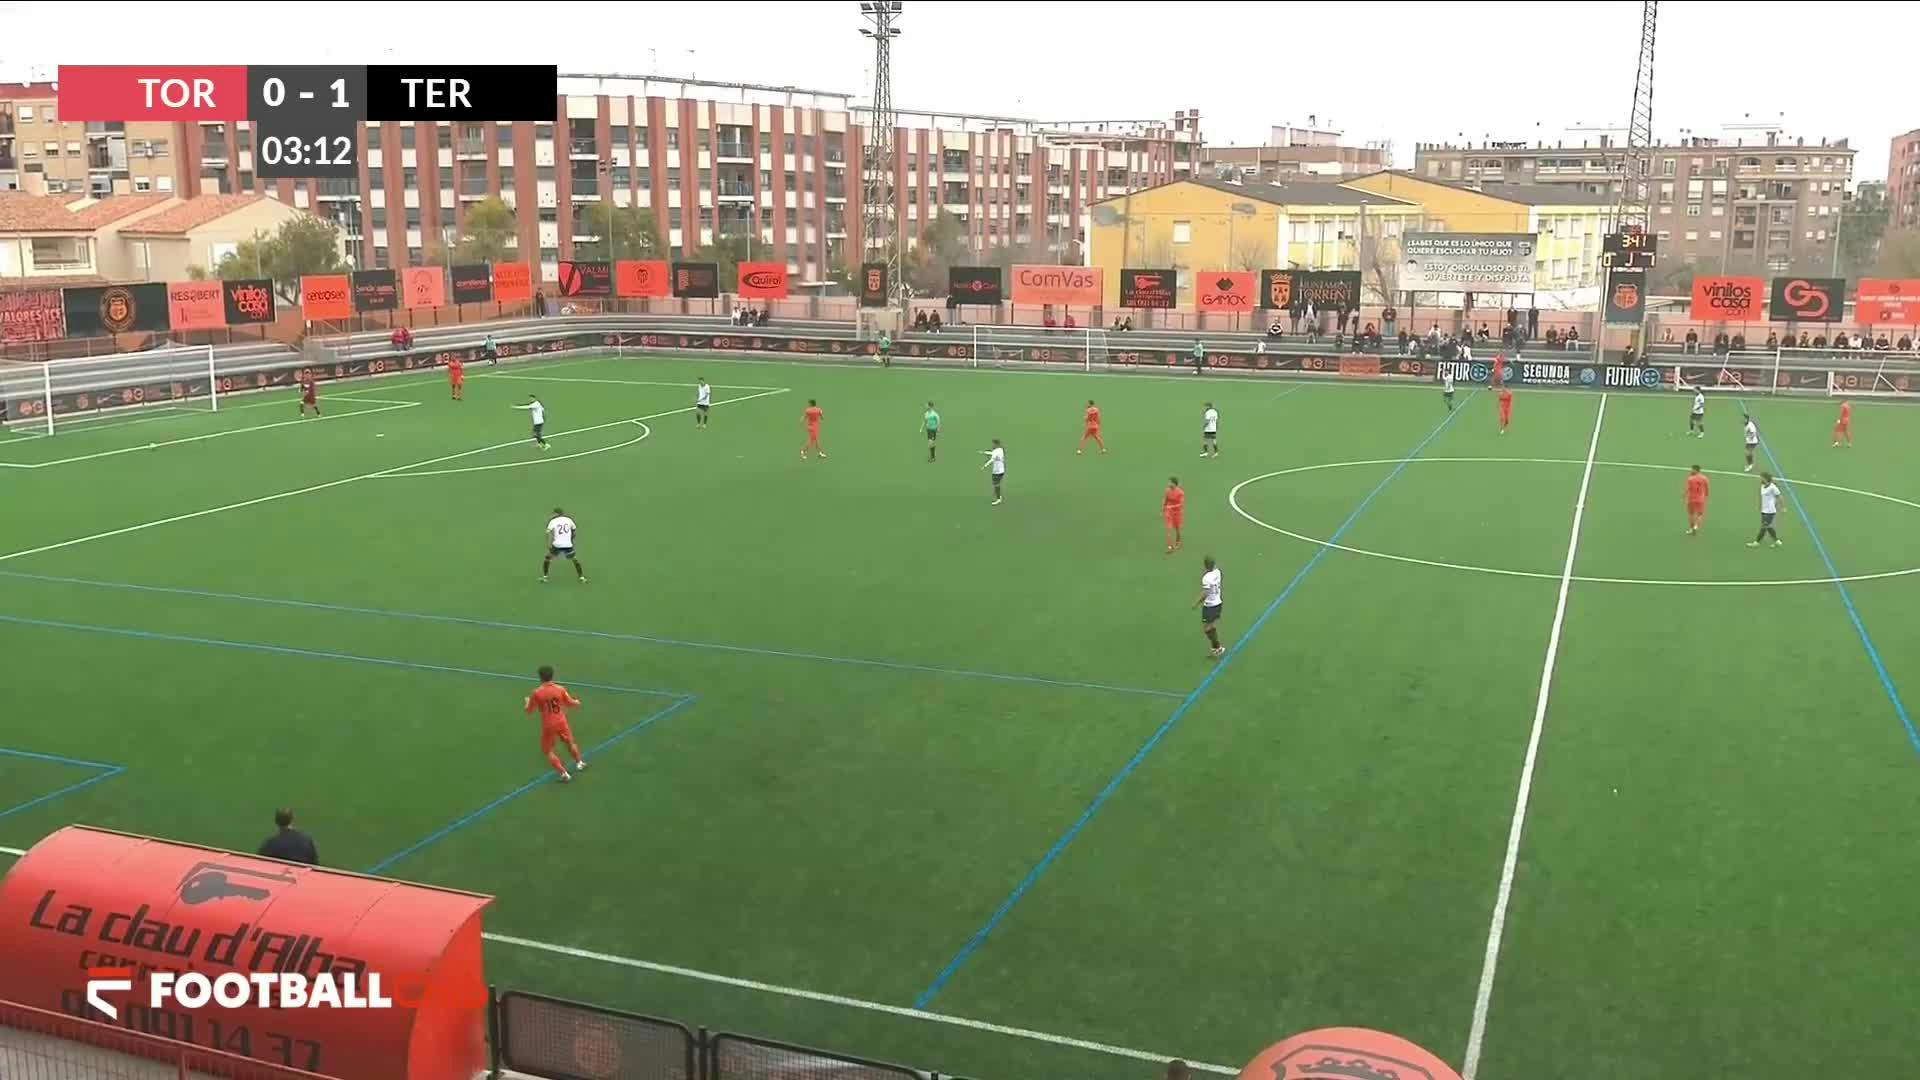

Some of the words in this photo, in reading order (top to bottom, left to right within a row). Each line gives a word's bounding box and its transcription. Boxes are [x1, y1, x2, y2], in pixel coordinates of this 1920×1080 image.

[1460, 240, 1471, 248] LO
[1436, 248, 1477, 256] ESCUCHAR
[1479, 248, 1490, 256] TU
[1490, 248, 1513, 257] HIJO?
[1424, 264, 1449, 273] ESTOY
[1452, 264, 1505, 274] ORGULLOSO
[1506, 265, 1517, 274] DE
[1020, 270, 1094, 288] ComVas
[1486, 273, 1530, 283] DISFRUTA
[231, 285, 268, 301] vinilos
[1298, 288, 1353, 301] TORRENT
[1702, 281, 1752, 298] vinilos
[1710, 297, 1750, 309] casa
[1523, 363, 1571, 379] SEGUNDA
[557, 523, 570, 535] 20
[29, 889, 93, 937] La
[98, 903, 202, 958] clau
